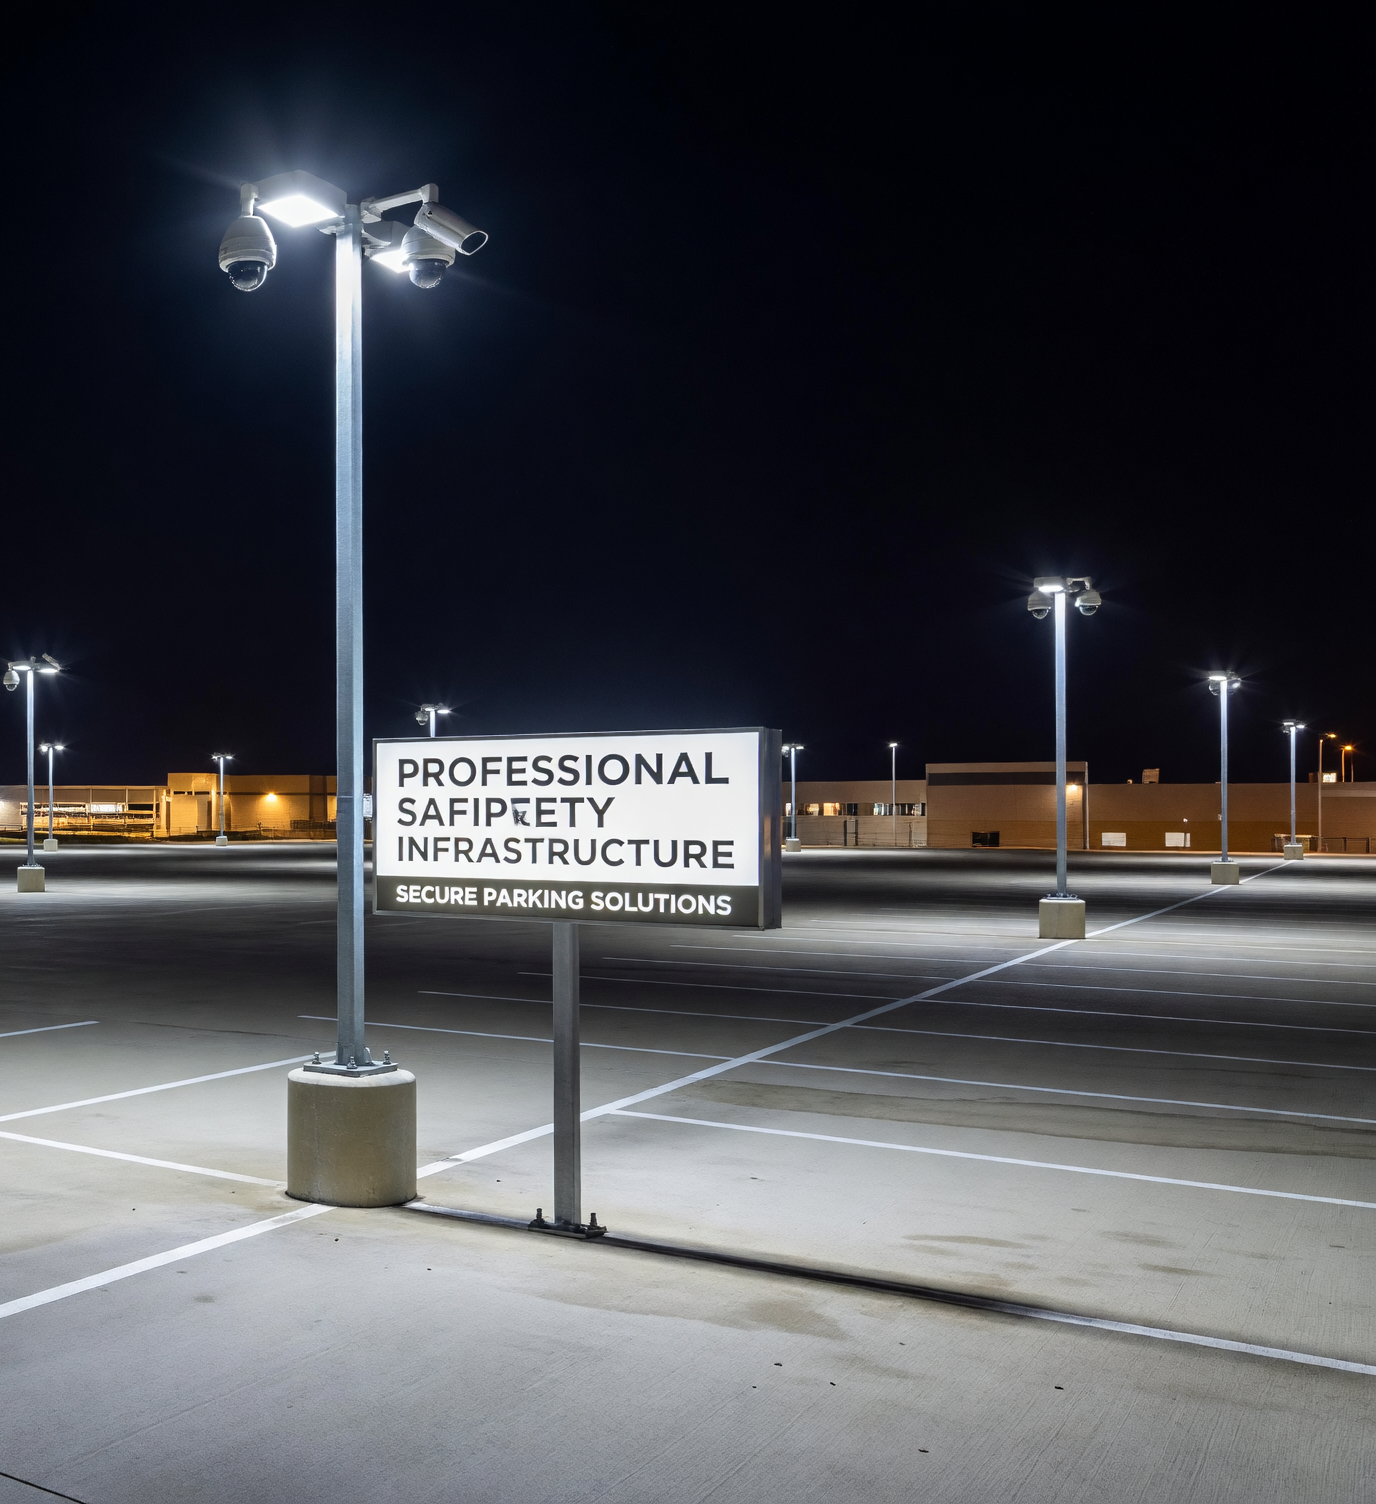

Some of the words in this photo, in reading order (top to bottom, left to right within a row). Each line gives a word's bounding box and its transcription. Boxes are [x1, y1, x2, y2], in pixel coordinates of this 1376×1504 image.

[398, 751, 730, 788] PROFESSIONAL
[398, 836, 735, 870] INFRASTRUCTURE
[395, 884, 478, 906] SECURE
[483, 887, 585, 910] PARKING
[590, 890, 732, 916] SOLUTIONS
